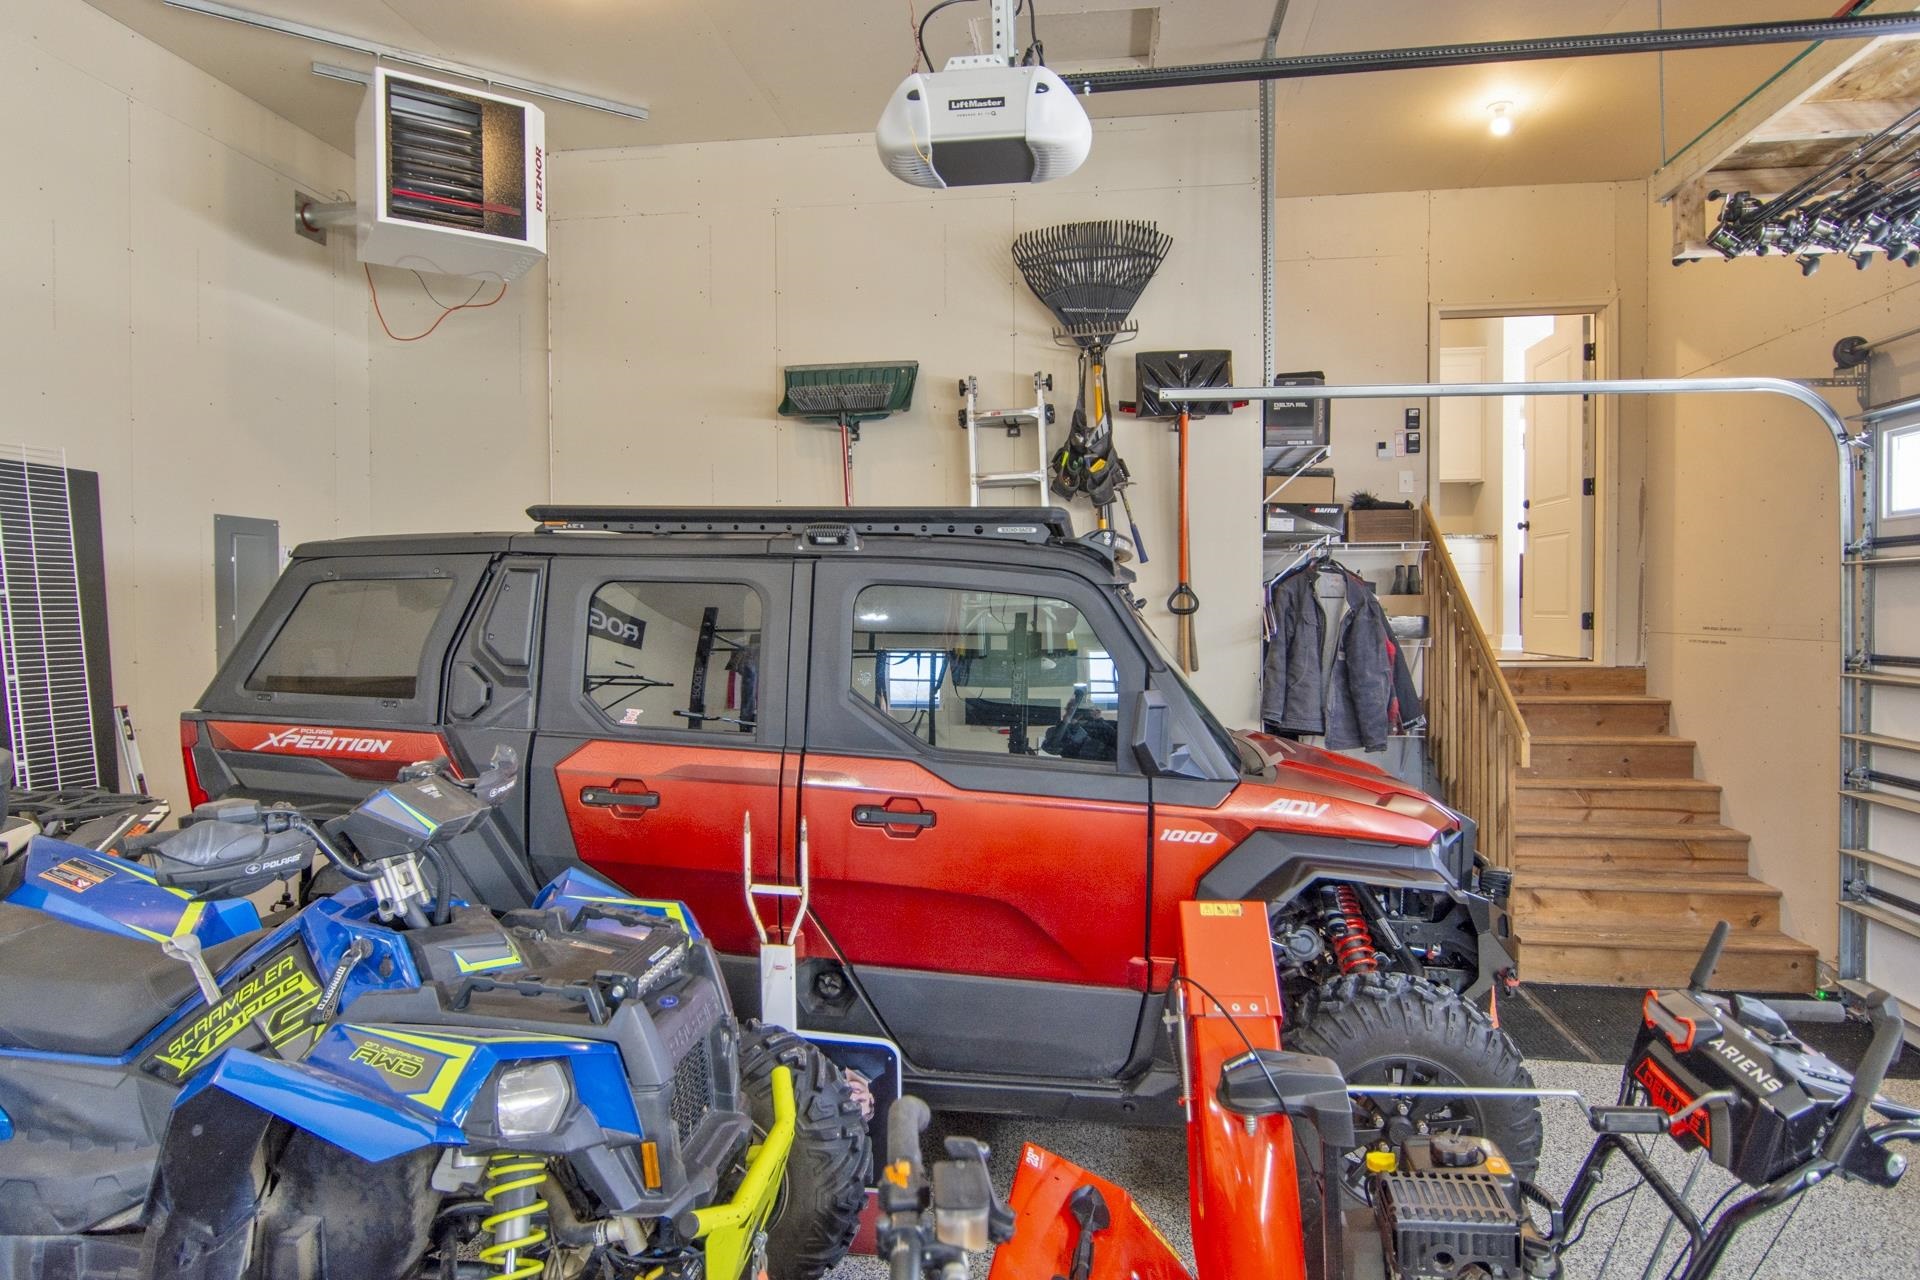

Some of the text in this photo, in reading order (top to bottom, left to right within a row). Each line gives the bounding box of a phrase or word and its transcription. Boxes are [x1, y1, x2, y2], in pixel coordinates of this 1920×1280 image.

[951, 99, 1002, 109] LiftMaster
[535, 145, 543, 213] REZNOR
[252, 728, 393, 753] XPEDITION
[300, 728, 333, 736] POLARIS
[1263, 798, 1330, 818] ADV
[1160, 828, 1219, 845] 1000
[262, 853, 302, 870] POLARIS
[168, 955, 294, 1057] SCRAMBLER
[348, 1046, 423, 1079] AWD
[363, 1041, 425, 1063] ON DEMAND
[1708, 1039, 1783, 1092] ARIENS
